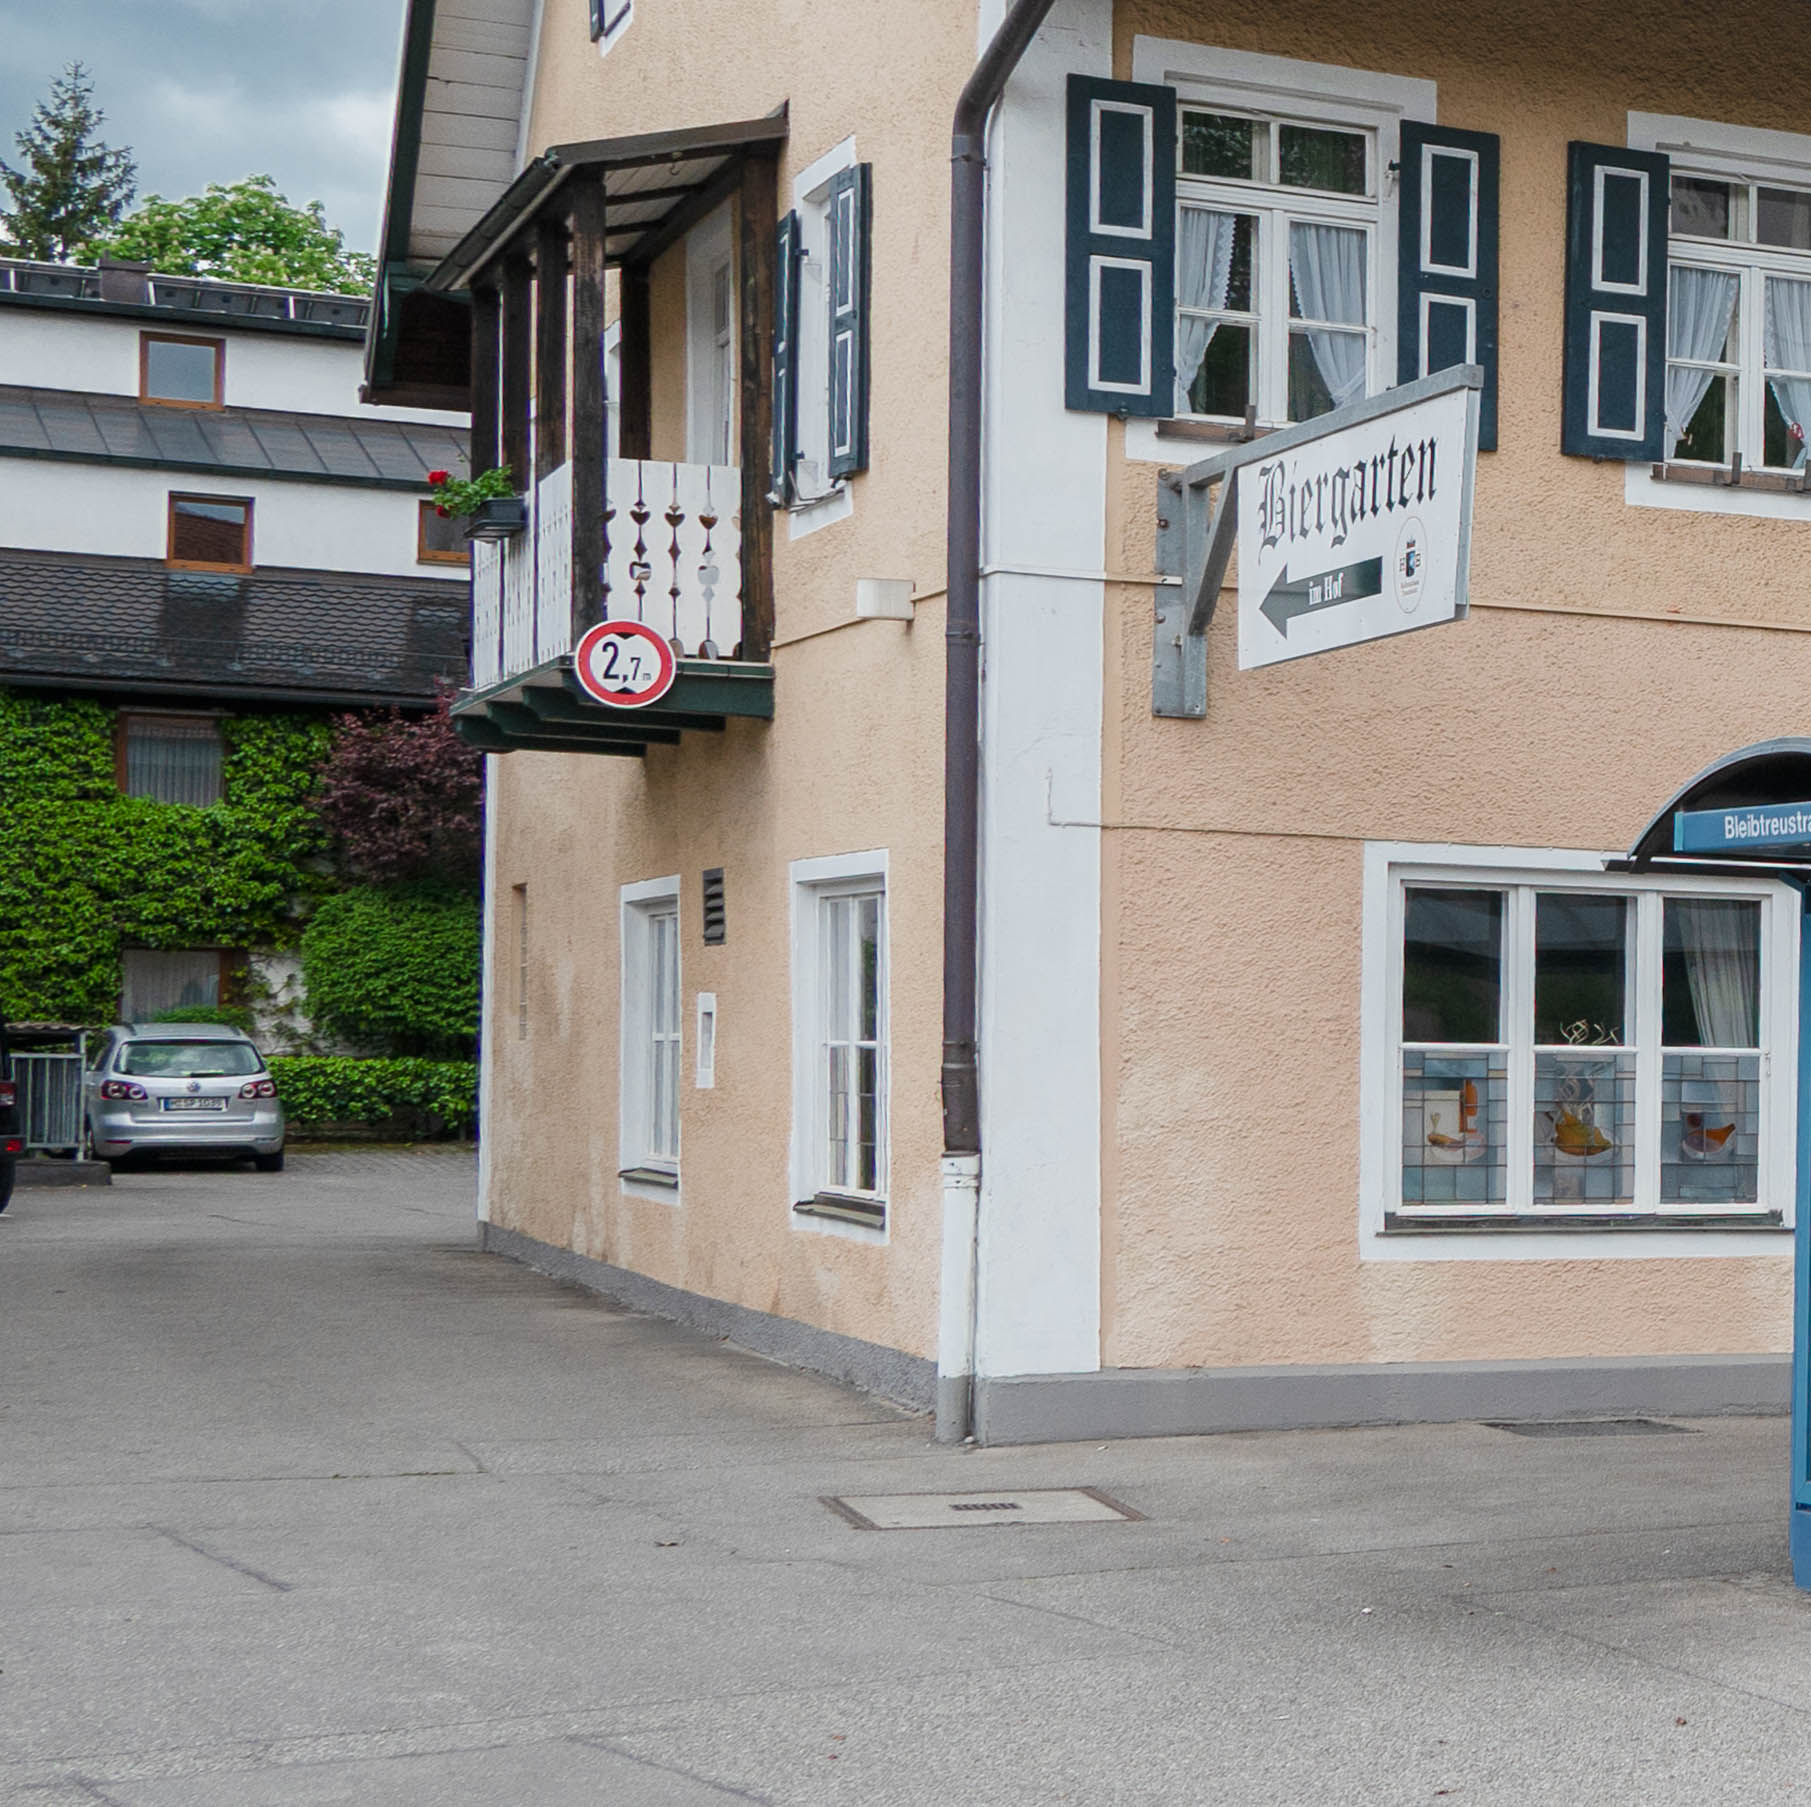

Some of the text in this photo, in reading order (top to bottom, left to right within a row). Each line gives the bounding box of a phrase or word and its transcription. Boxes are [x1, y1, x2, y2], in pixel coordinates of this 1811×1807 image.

[1258, 434, 1438, 566] Biergarten
[1309, 573, 1344, 605] im Hof
[602, 641, 642, 682] 2,7
